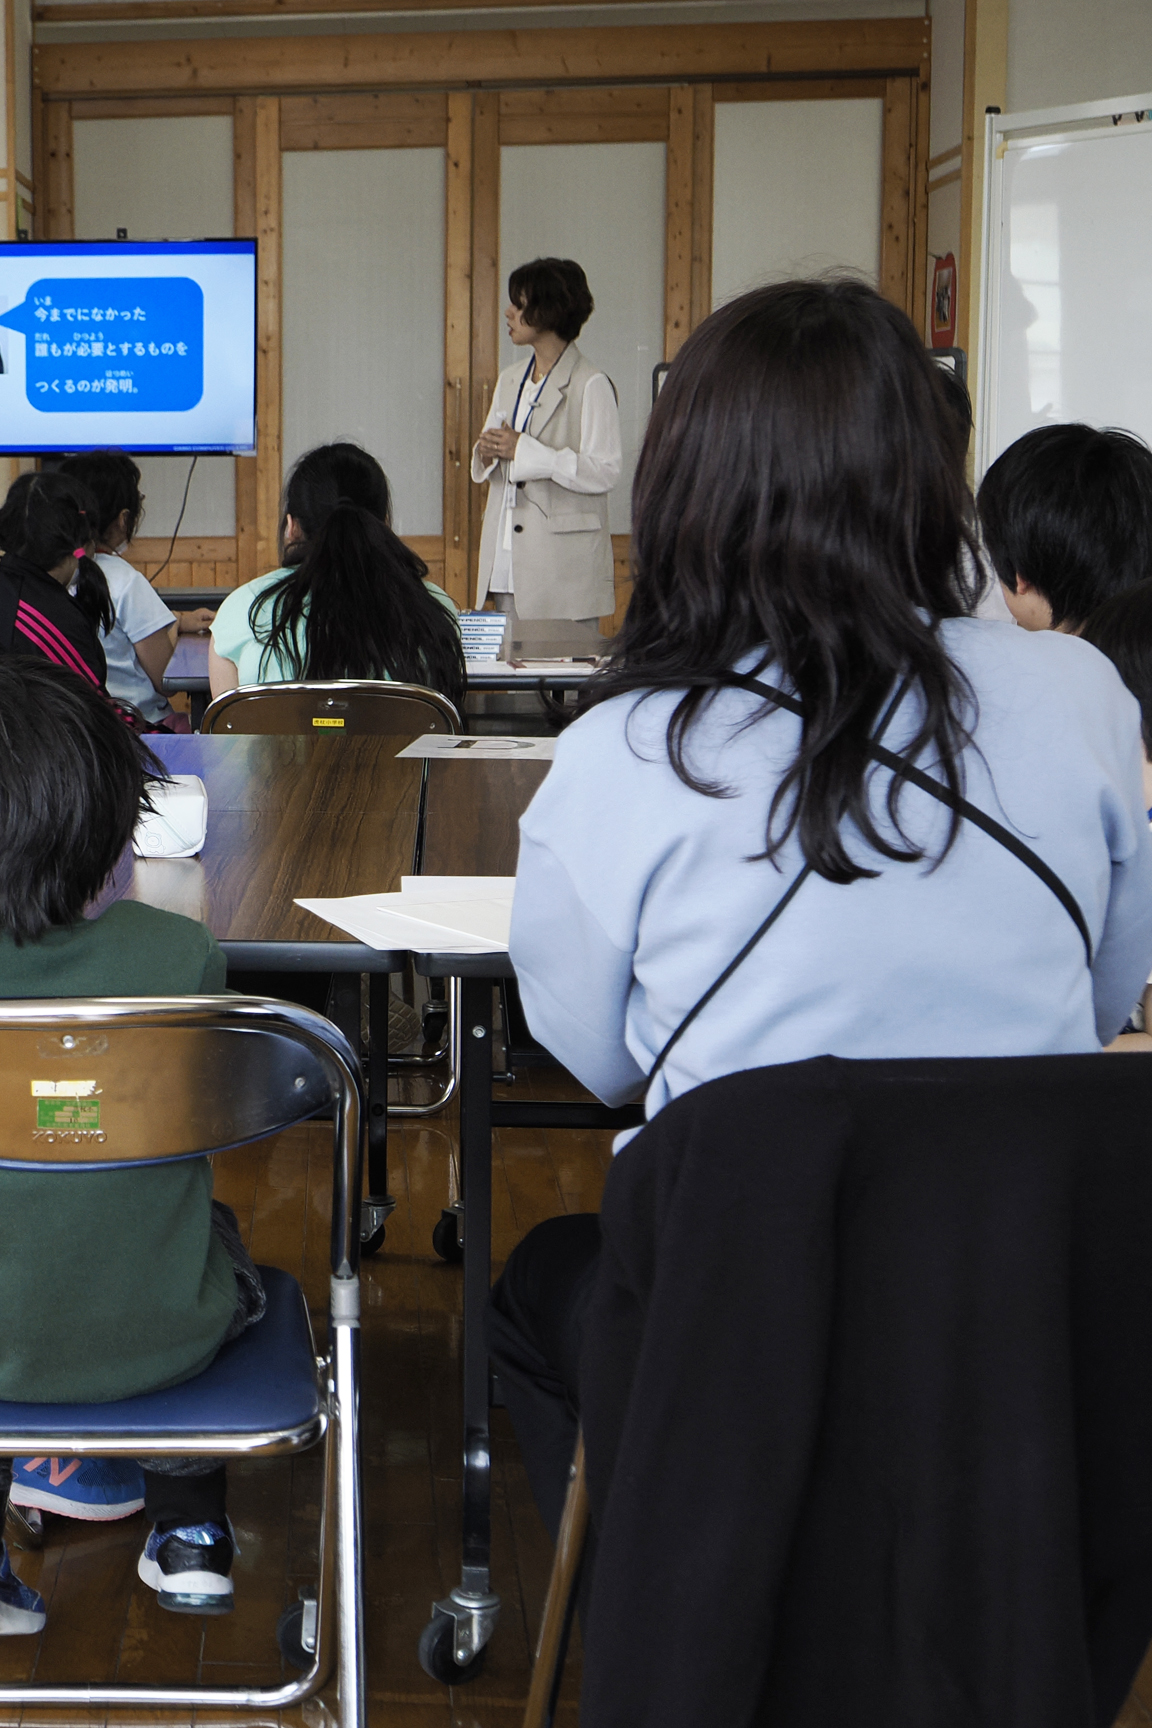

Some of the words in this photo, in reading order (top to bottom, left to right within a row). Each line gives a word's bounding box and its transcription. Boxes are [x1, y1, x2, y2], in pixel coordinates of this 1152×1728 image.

[34, 296, 53, 306] いま
[34, 306, 147, 322] 今までになかった
[34, 341, 189, 358] 誰もが必要とするものを
[34, 379, 141, 395] つくるのが発明。
[32, 1130, 108, 1144] KOKUYO
